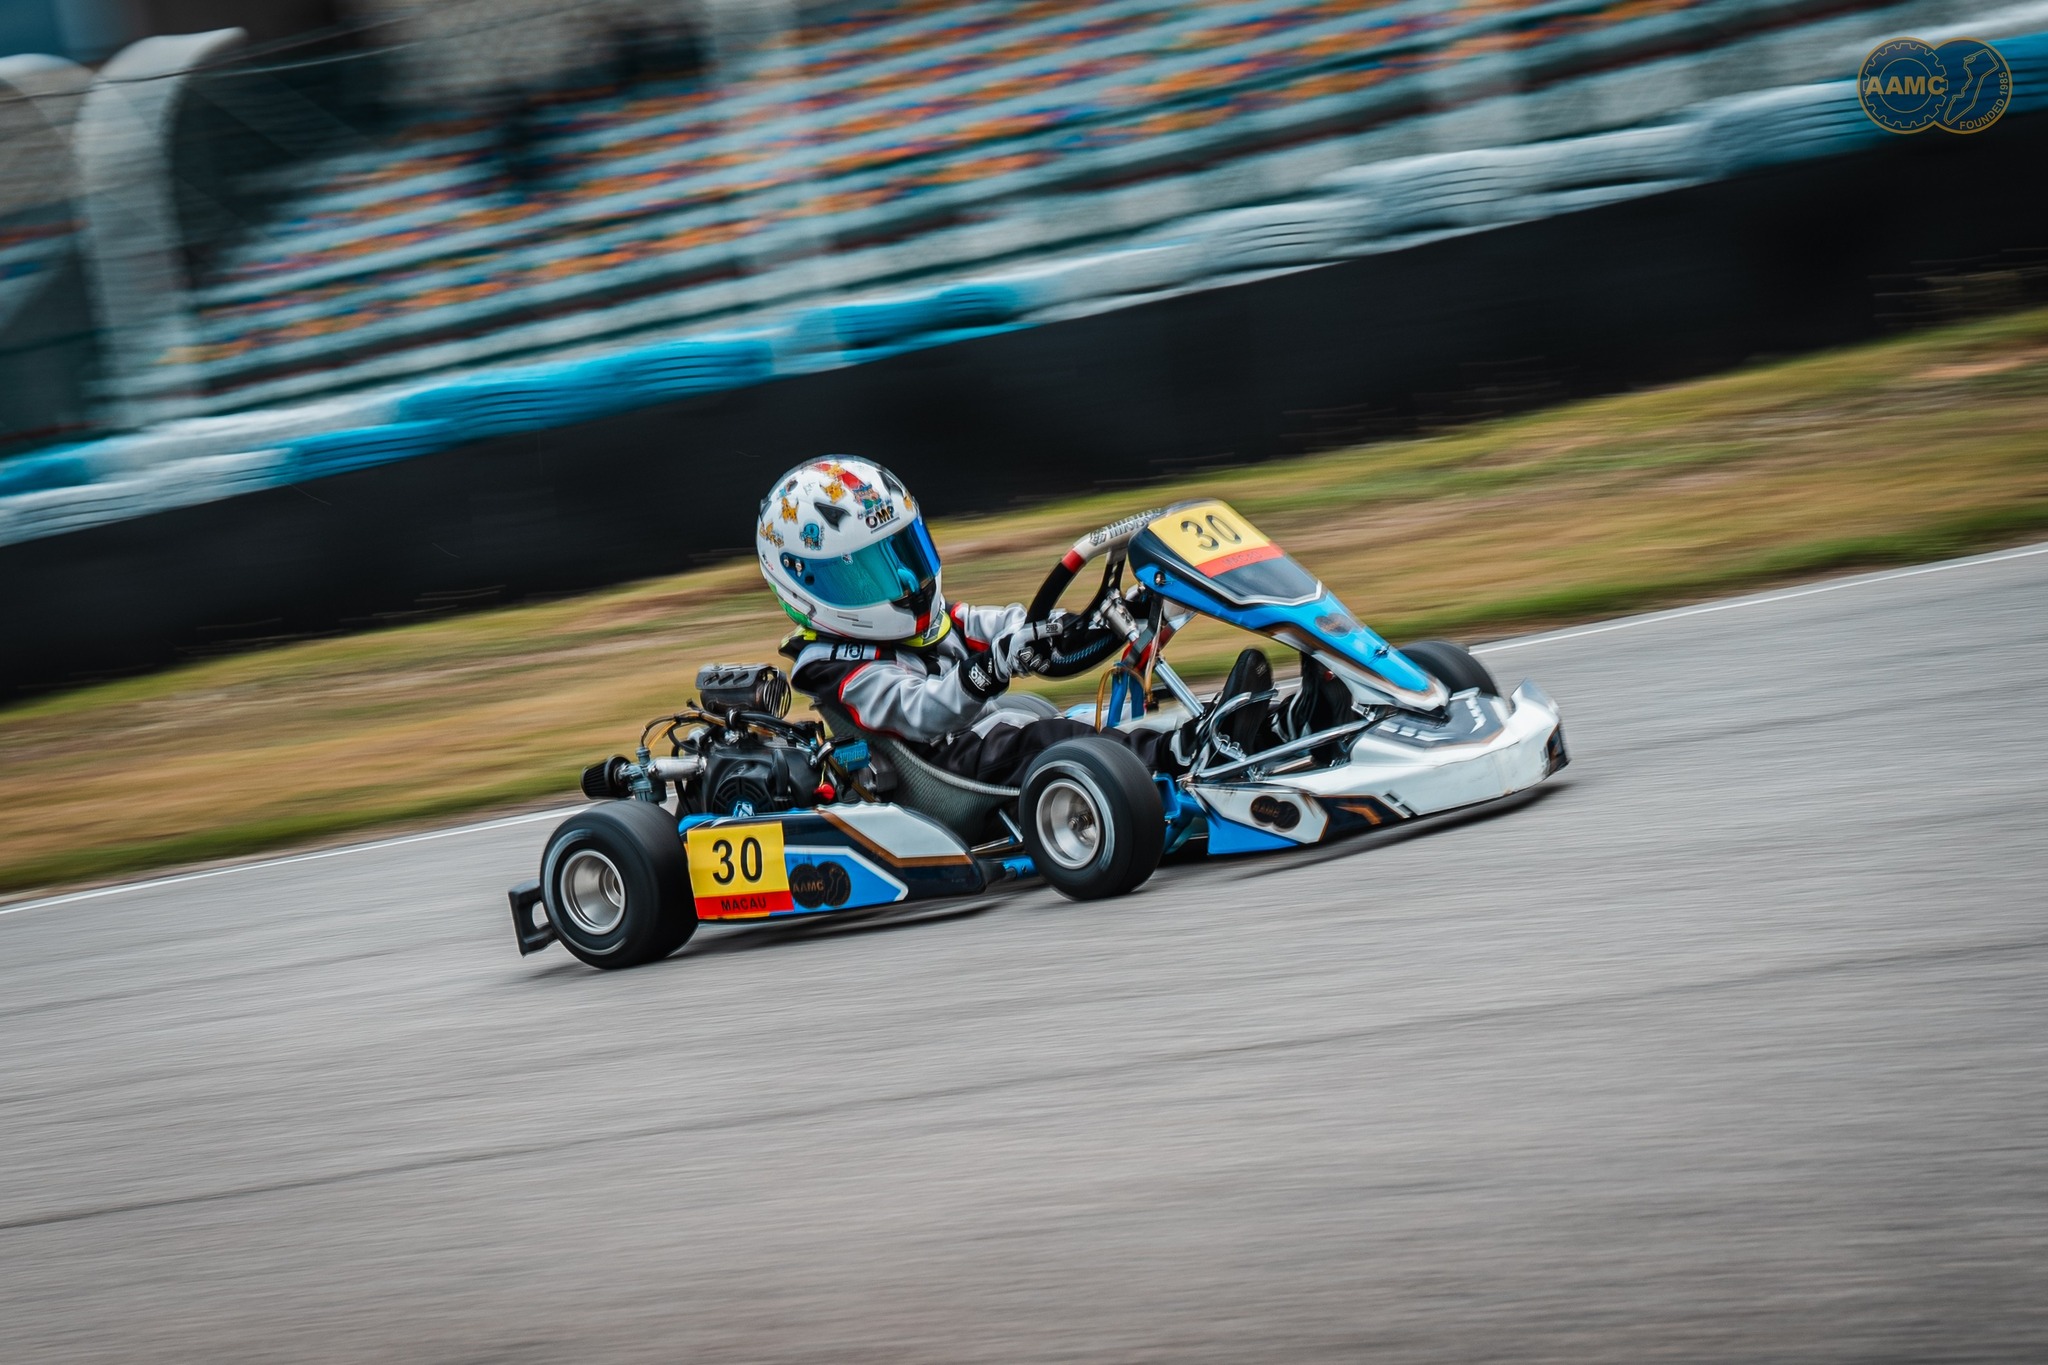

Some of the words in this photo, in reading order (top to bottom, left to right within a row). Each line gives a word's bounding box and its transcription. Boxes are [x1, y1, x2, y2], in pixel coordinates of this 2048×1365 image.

[866, 505, 895, 529] OMP
[1180, 514, 1242, 551] 30
[712, 836, 763, 885] 30
[793, 880, 824, 893] AAMC
[721, 896, 767, 911] MACAU
